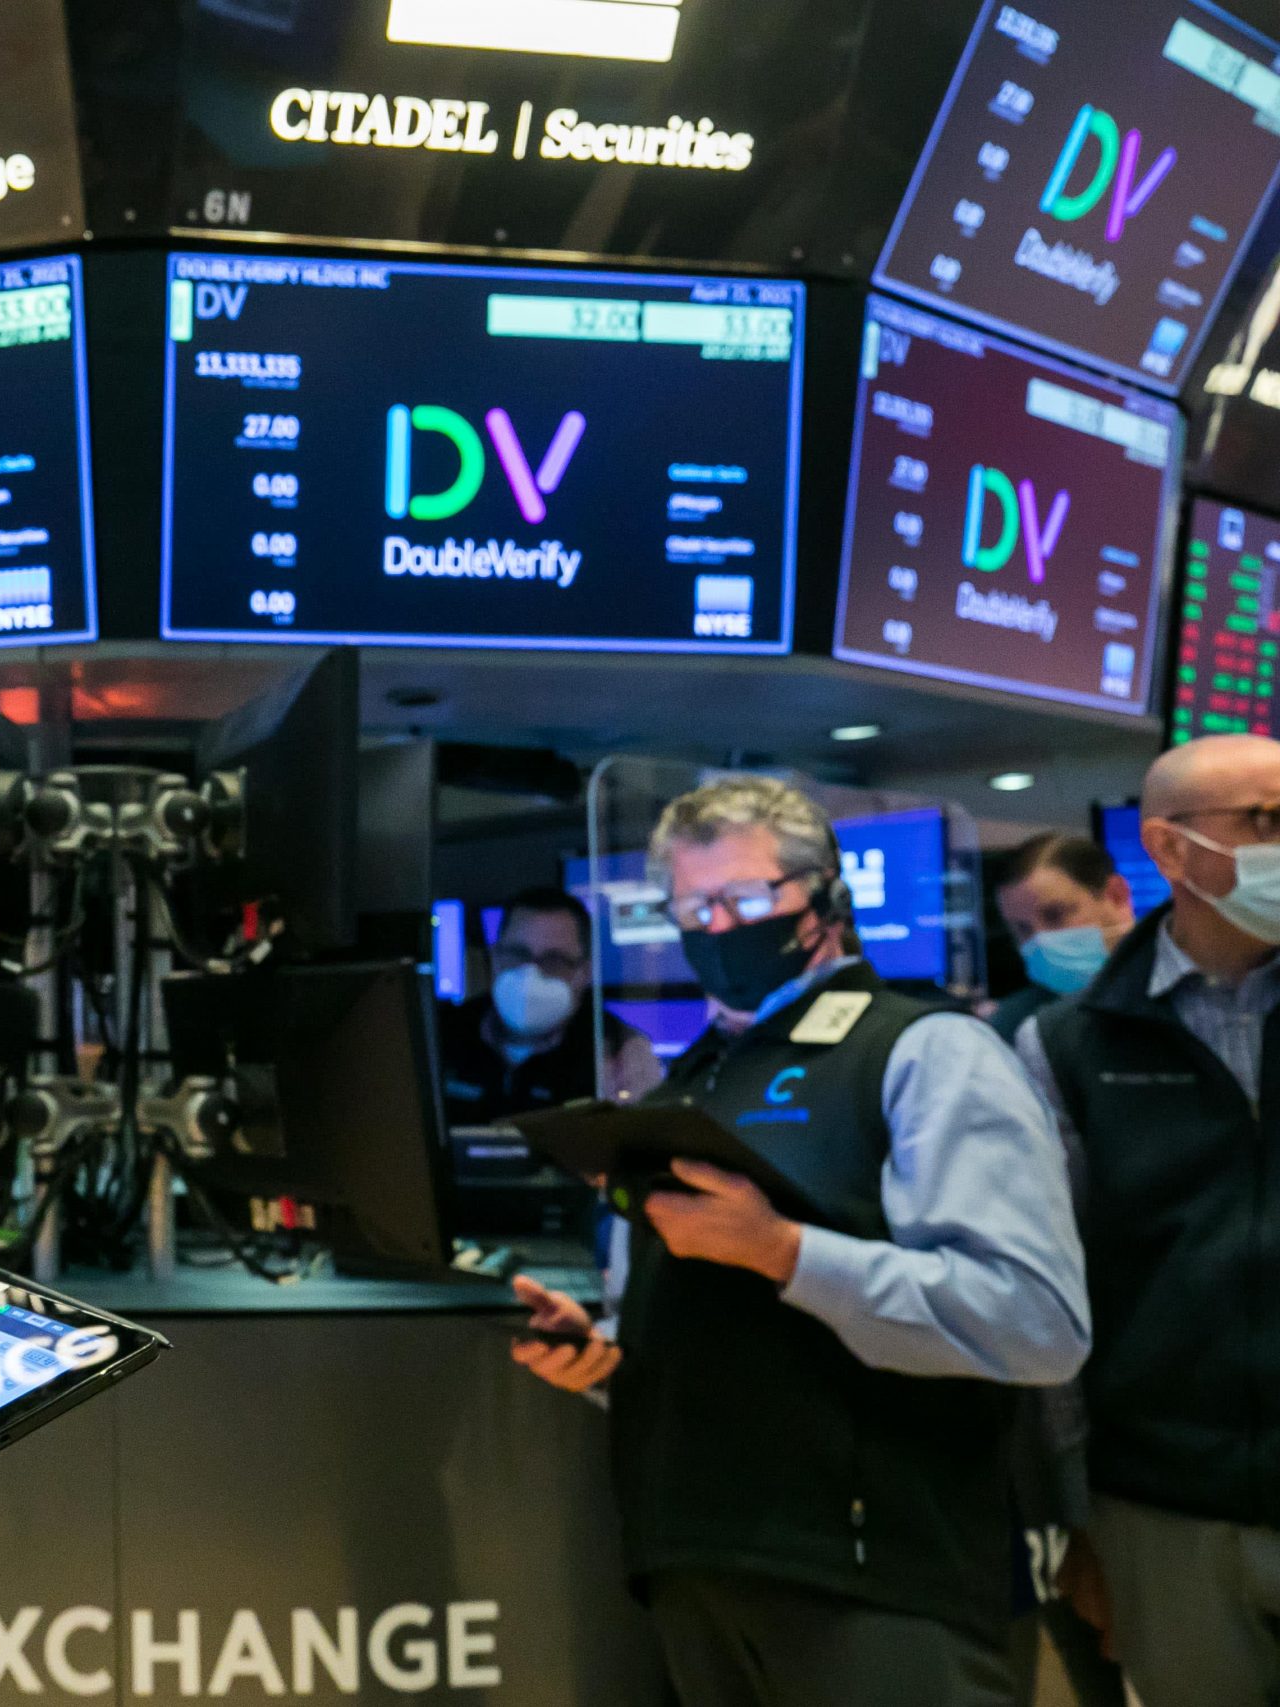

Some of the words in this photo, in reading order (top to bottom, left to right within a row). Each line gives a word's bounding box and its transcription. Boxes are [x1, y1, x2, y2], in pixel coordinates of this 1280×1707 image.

[269, 86, 498, 155] CITADEL
[540, 108, 755, 171] Securities
[195, 282, 249, 321] DV
[383, 403, 587, 526] DV
[383, 536, 583, 588] DoubleVerify
[960, 462, 1071, 584] DV
